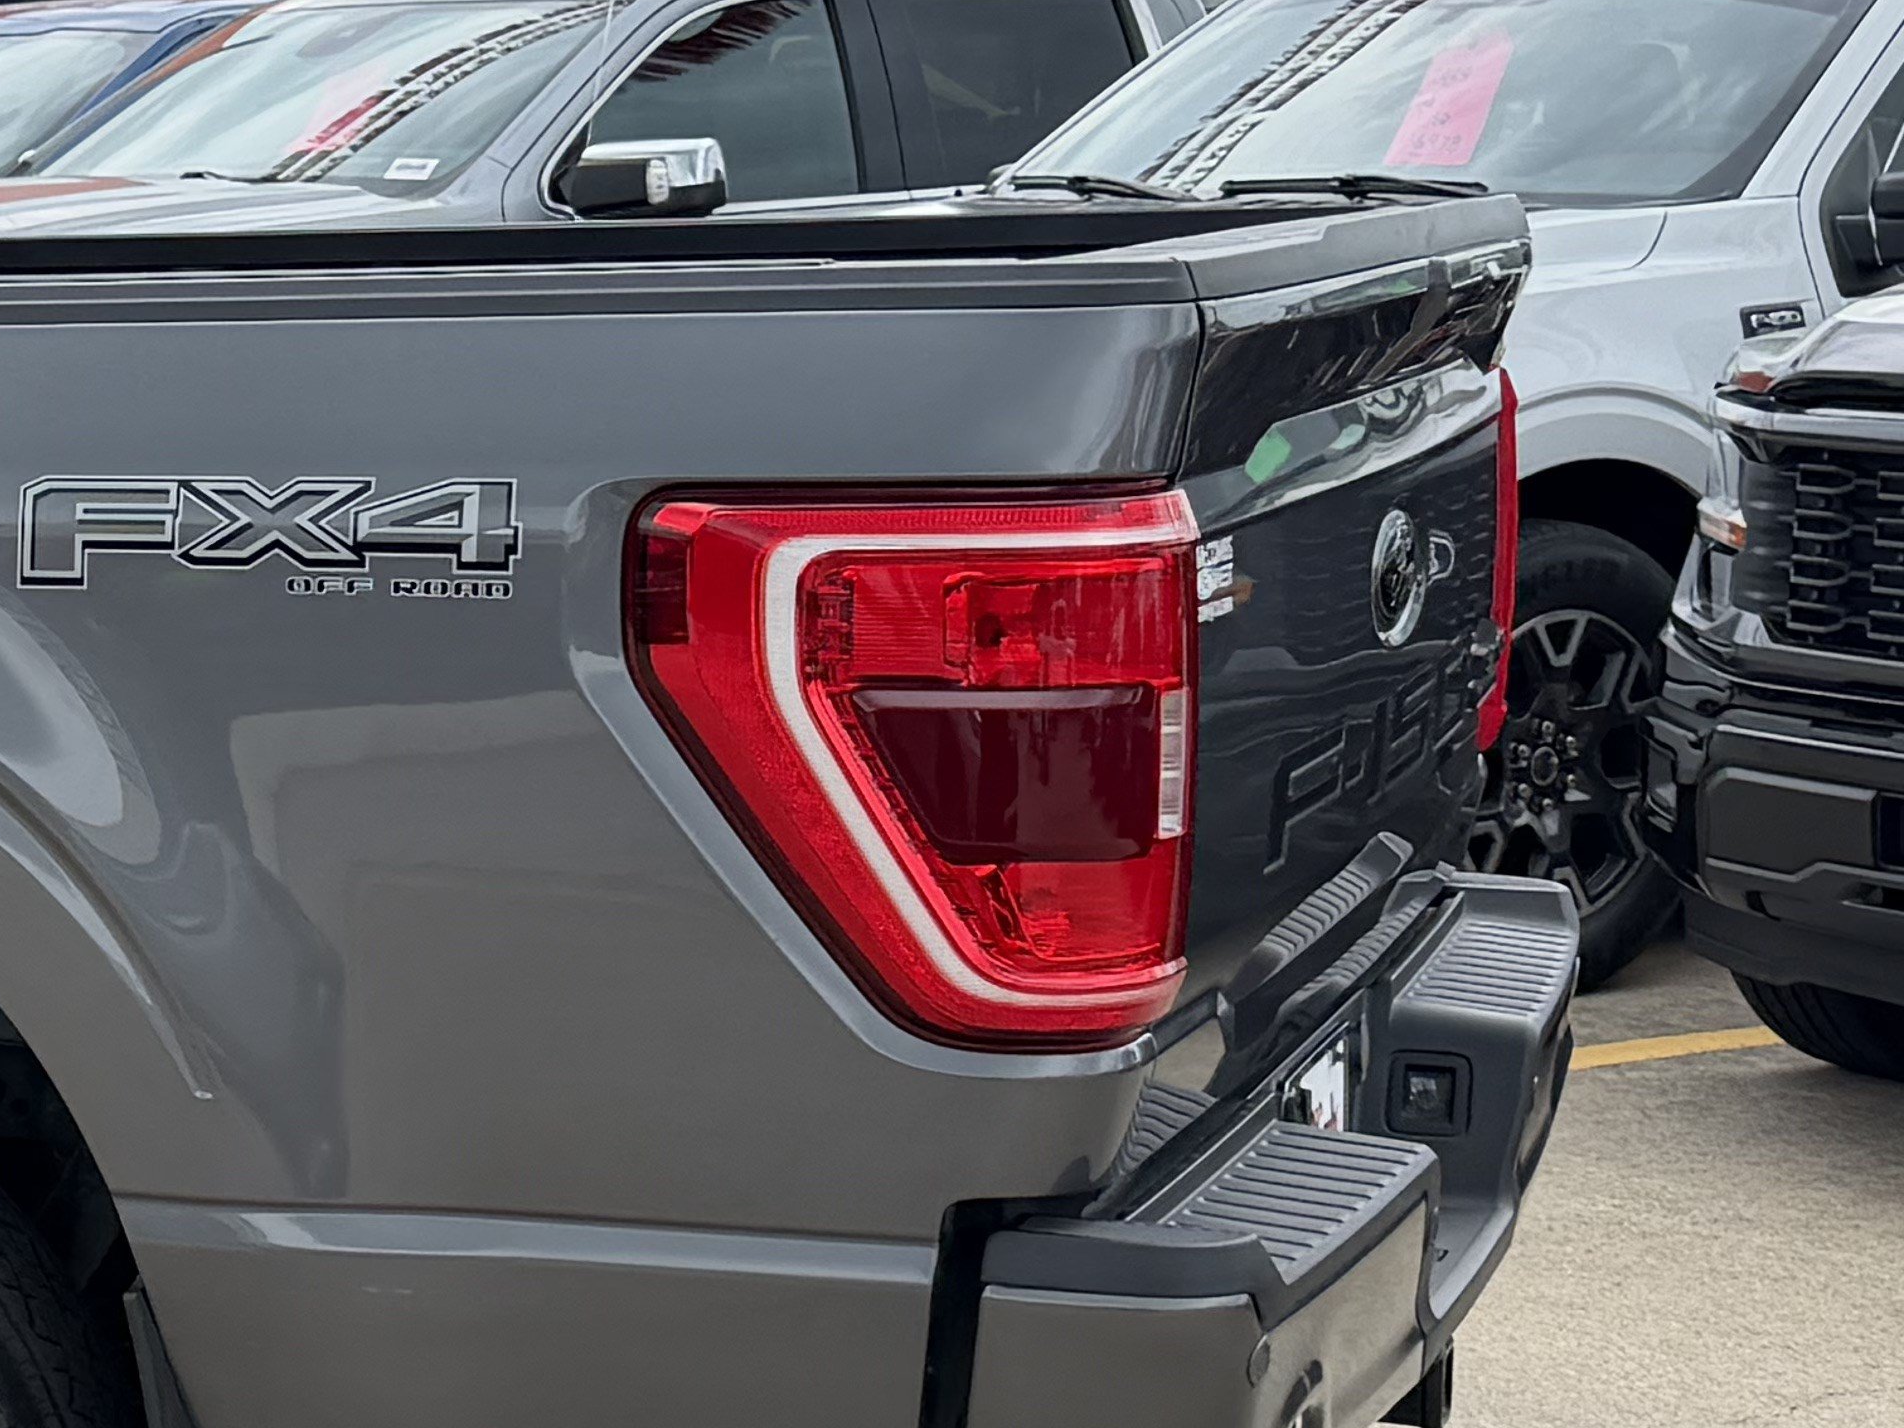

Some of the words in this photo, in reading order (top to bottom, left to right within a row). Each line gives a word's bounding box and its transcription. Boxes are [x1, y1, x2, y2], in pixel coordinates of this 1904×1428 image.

[17, 475, 522, 590] FX4
[285, 575, 374, 596] OFF
[390, 577, 513, 599] ROAD
